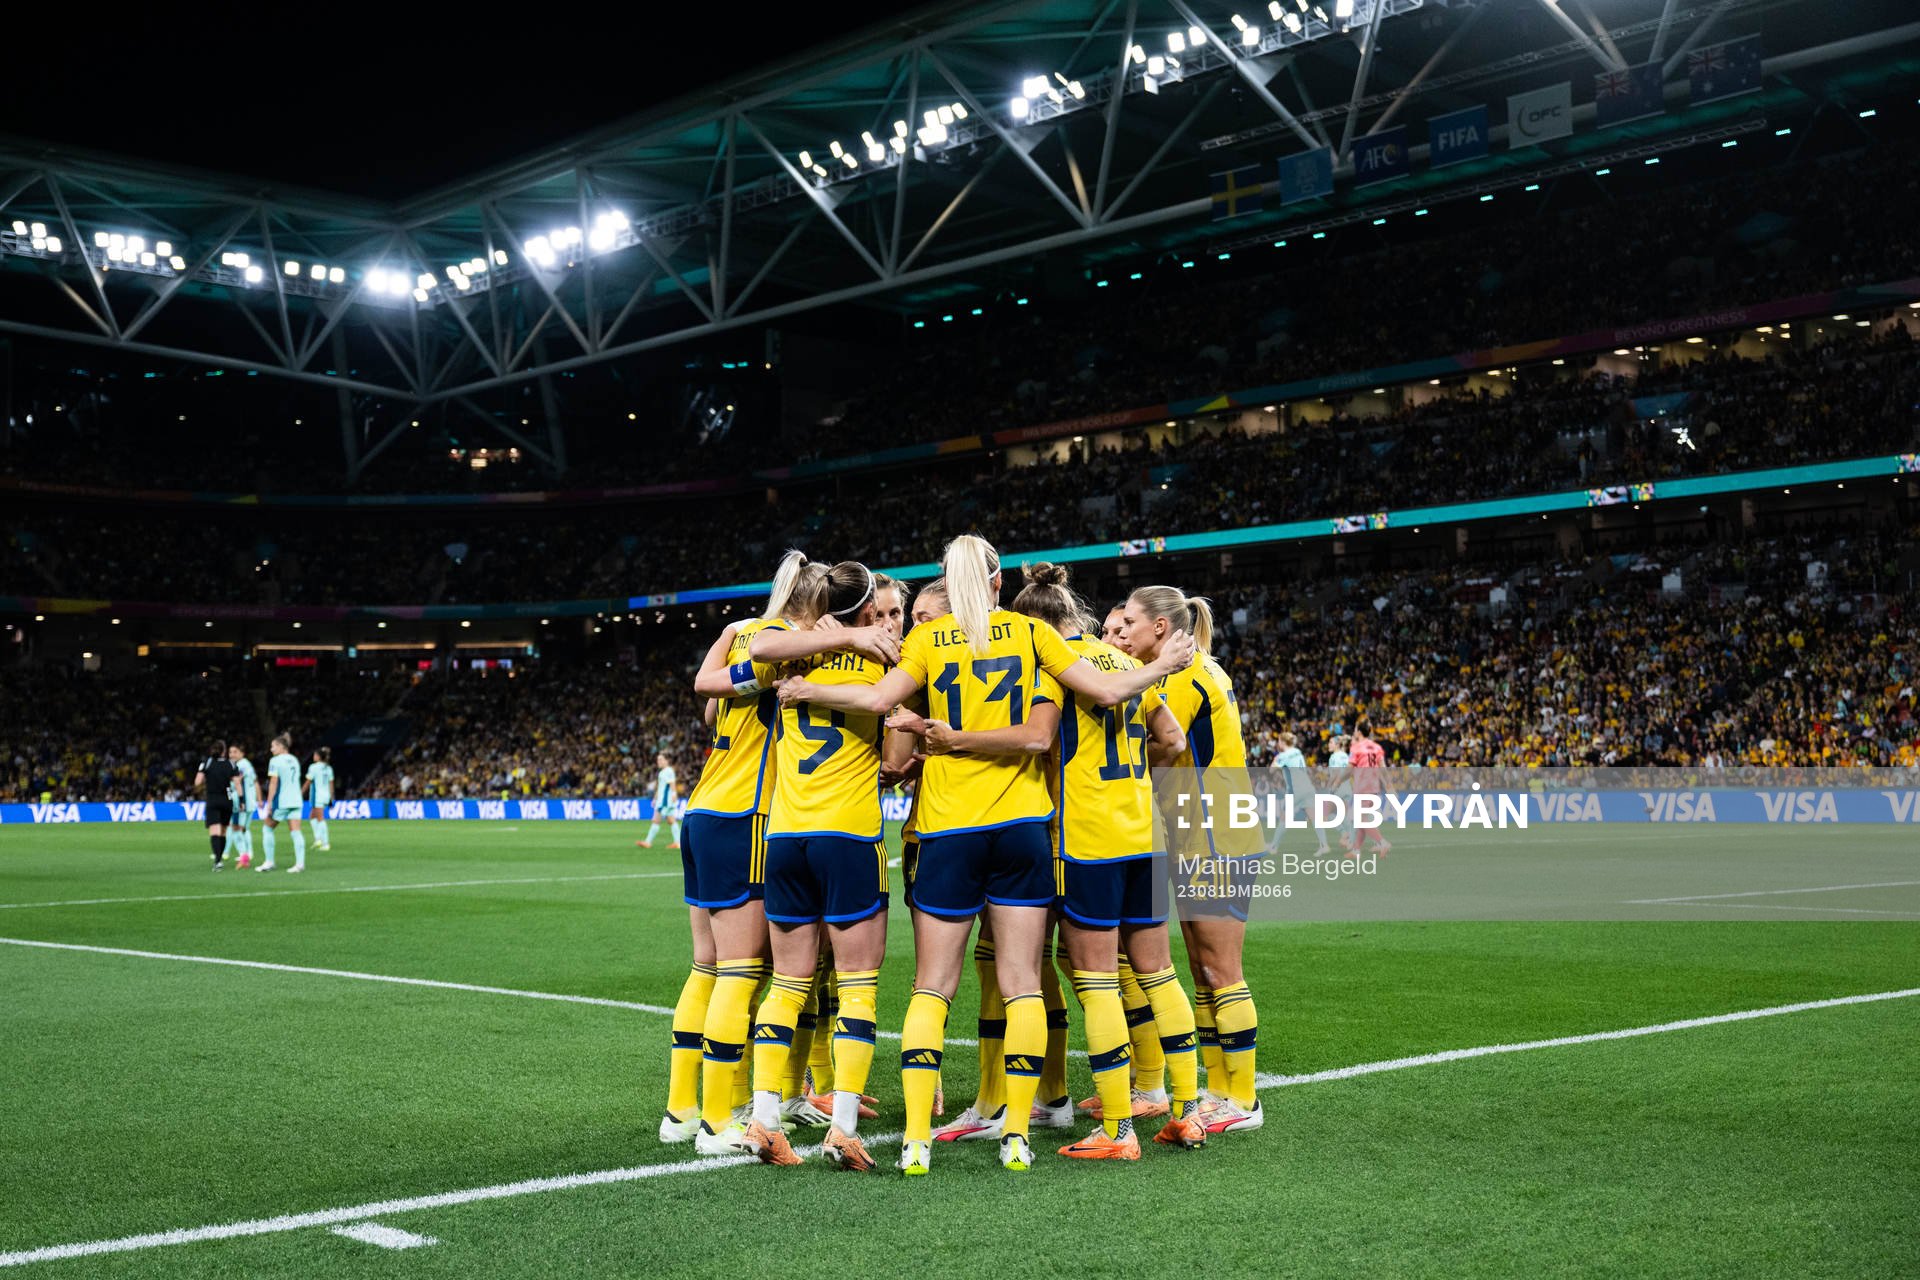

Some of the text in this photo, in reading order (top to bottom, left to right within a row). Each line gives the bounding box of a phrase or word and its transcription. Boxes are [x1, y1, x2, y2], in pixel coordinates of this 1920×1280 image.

[1438, 125, 1480, 151] FIFA
[1361, 144, 1398, 171] AFC
[1614, 310, 1747, 342] BEYOND GREATNESS
[933, 623, 1012, 647] ILEDT
[933, 655, 1024, 731] 17
[1091, 693, 1147, 781] 16
[28, 803, 80, 823] VISA
[106, 802, 156, 822] VISA
[181, 801, 206, 821] VI
[329, 800, 370, 819] VISA
[395, 801, 424, 819] VISA
[437, 801, 464, 819] VISA
[478, 801, 505, 819] VISA
[519, 801, 548, 819] VISA
[562, 801, 593, 819] VISA
[608, 801, 640, 819] VISA
[1530, 792, 1603, 822] VISA
[1638, 792, 1716, 822] VISA
[1755, 791, 1838, 823] VISA
[1881, 791, 1920, 824] VI
